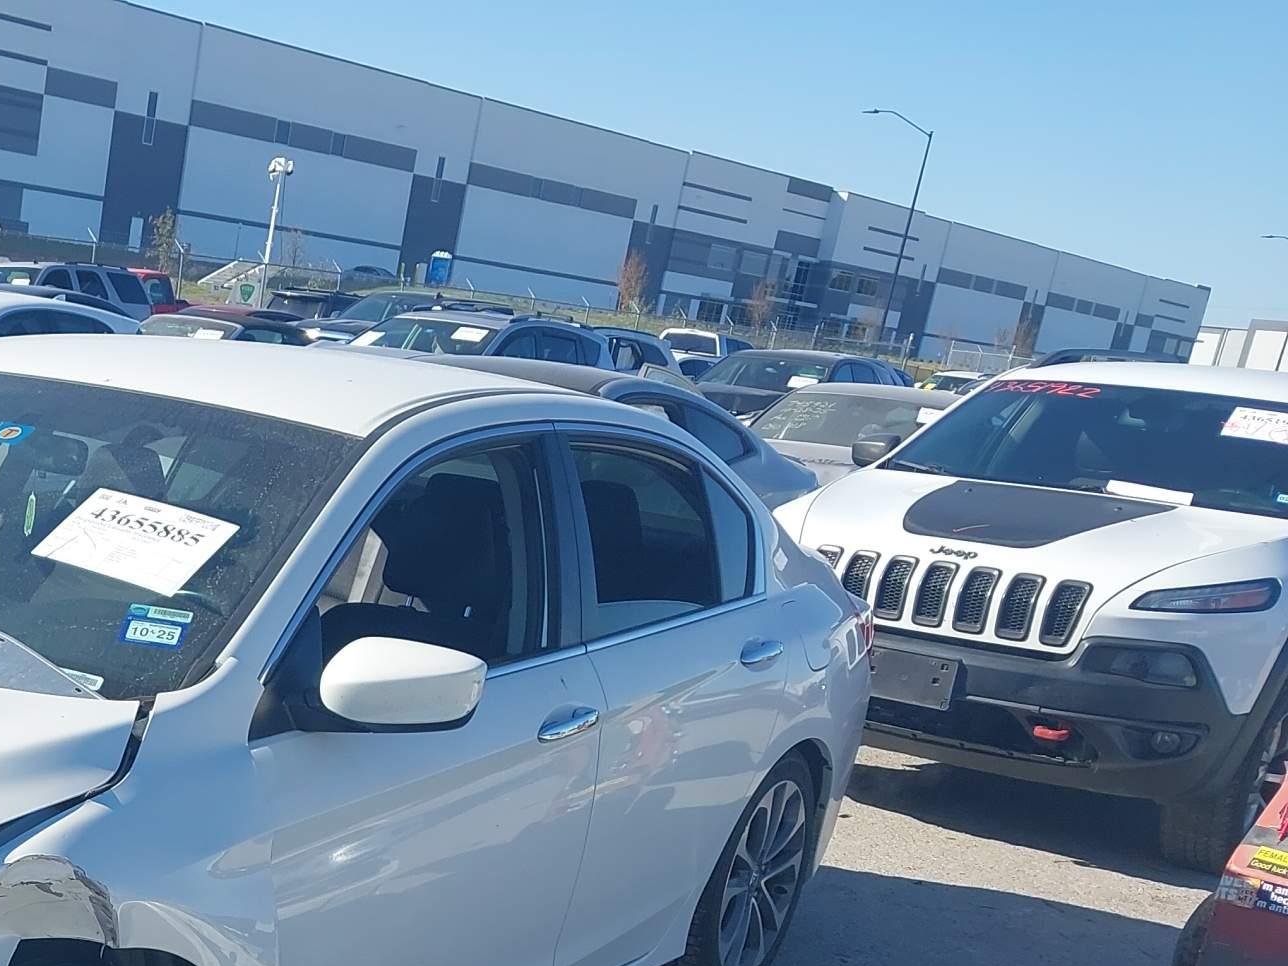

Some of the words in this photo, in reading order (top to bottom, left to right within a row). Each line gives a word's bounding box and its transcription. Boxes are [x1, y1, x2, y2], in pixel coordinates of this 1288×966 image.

[90, 507, 205, 546] 43655885
[929, 544, 979, 560] Jeep
[1250, 859, 1273, 870] Good
